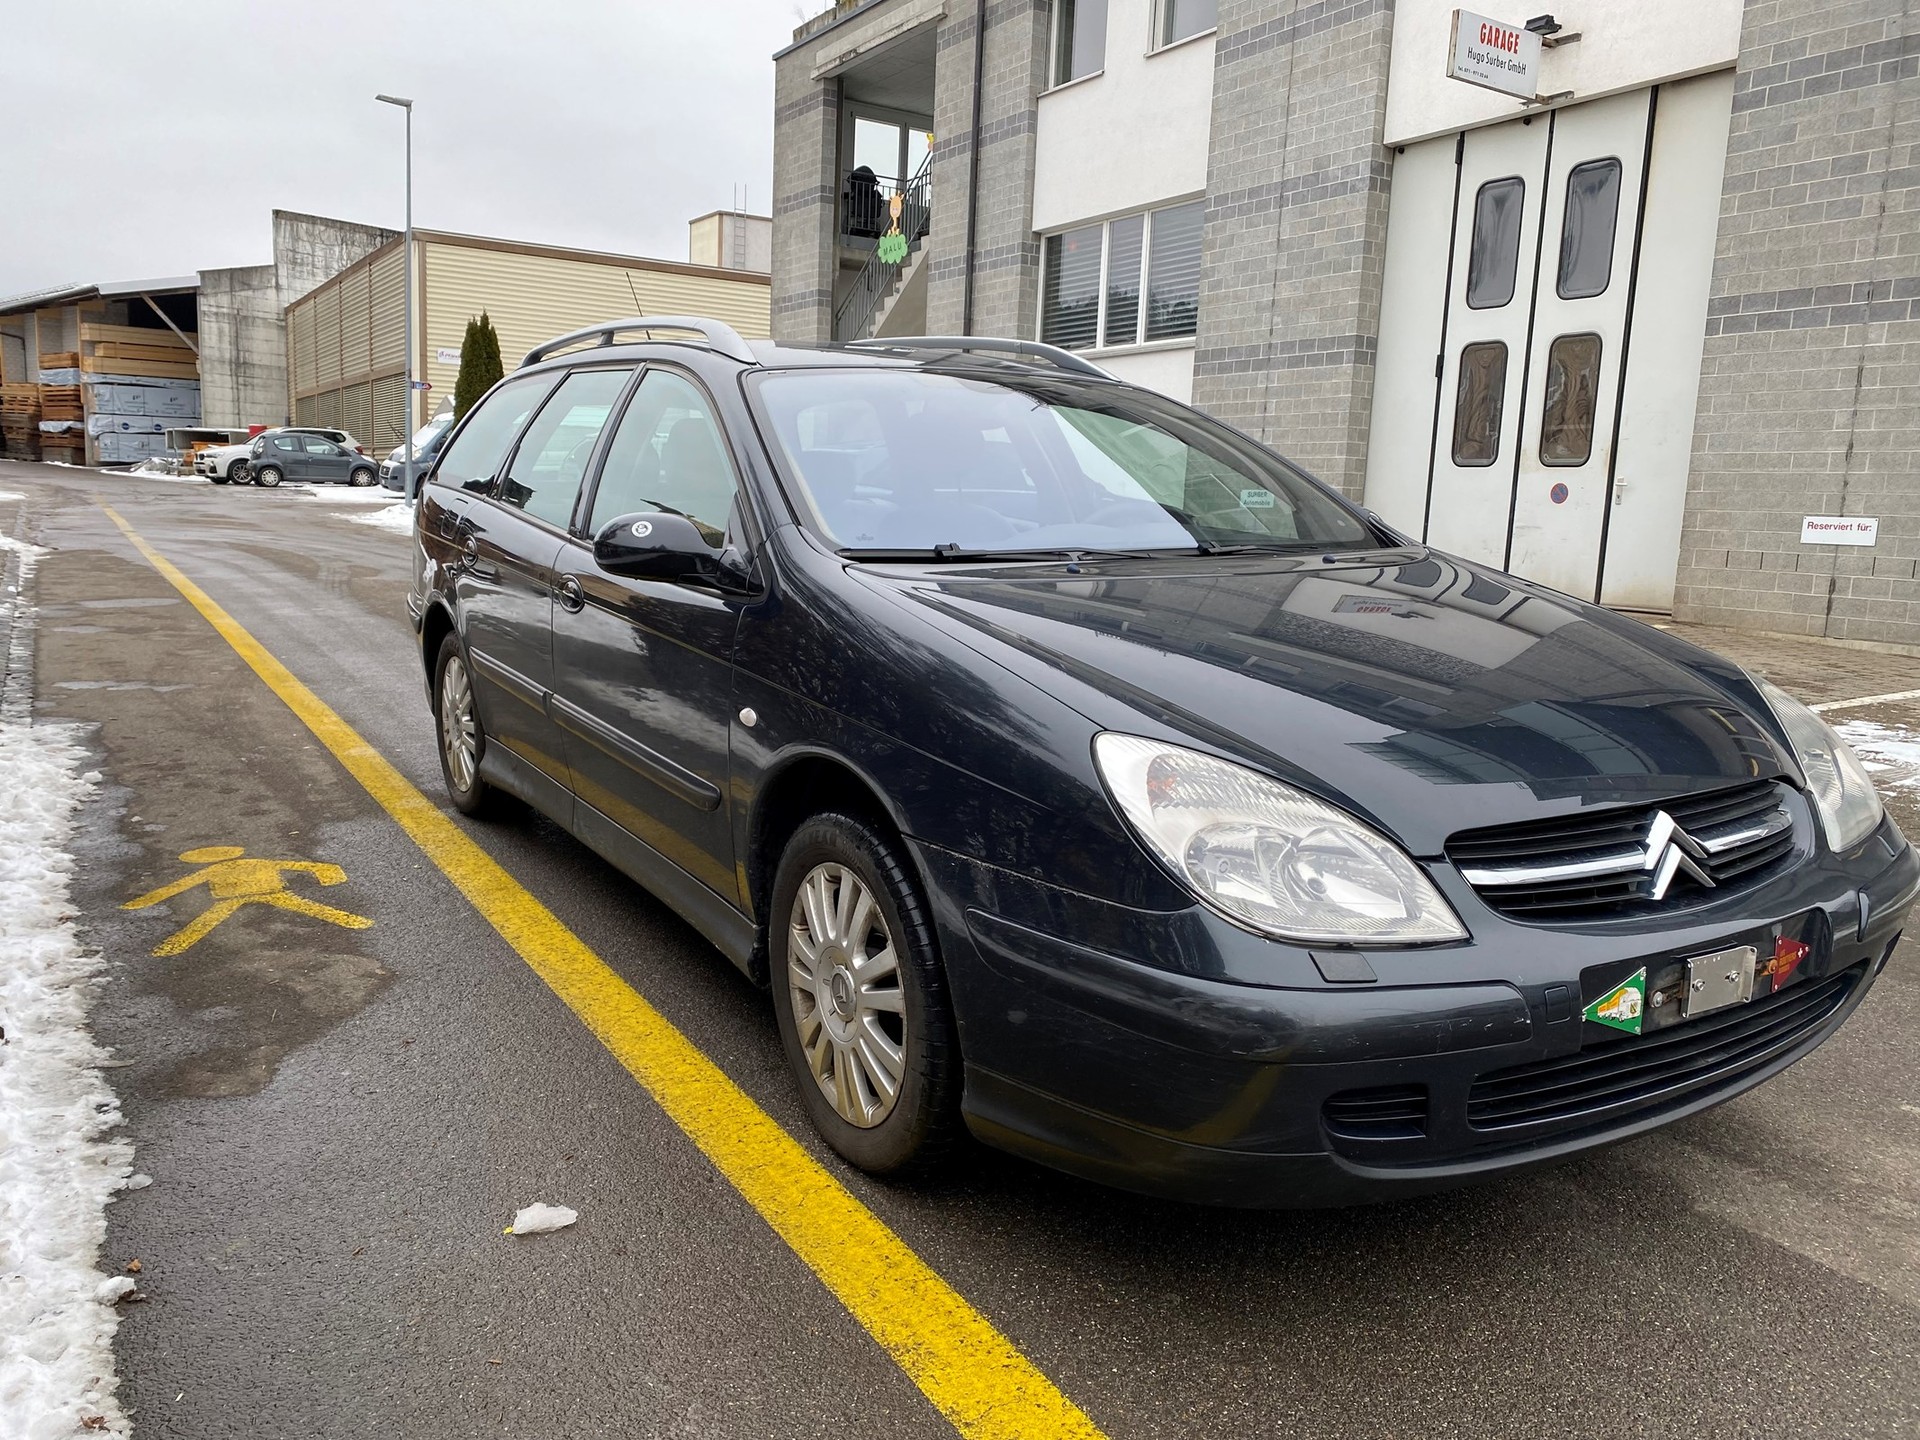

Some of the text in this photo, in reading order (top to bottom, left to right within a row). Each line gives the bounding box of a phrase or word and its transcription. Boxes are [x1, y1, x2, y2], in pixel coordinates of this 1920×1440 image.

[1480, 23, 1519, 54] GARAGE
[1467, 46, 1527, 75] Hugo Surber GmbH
[1806, 521, 1872, 532] Reserviert für:
